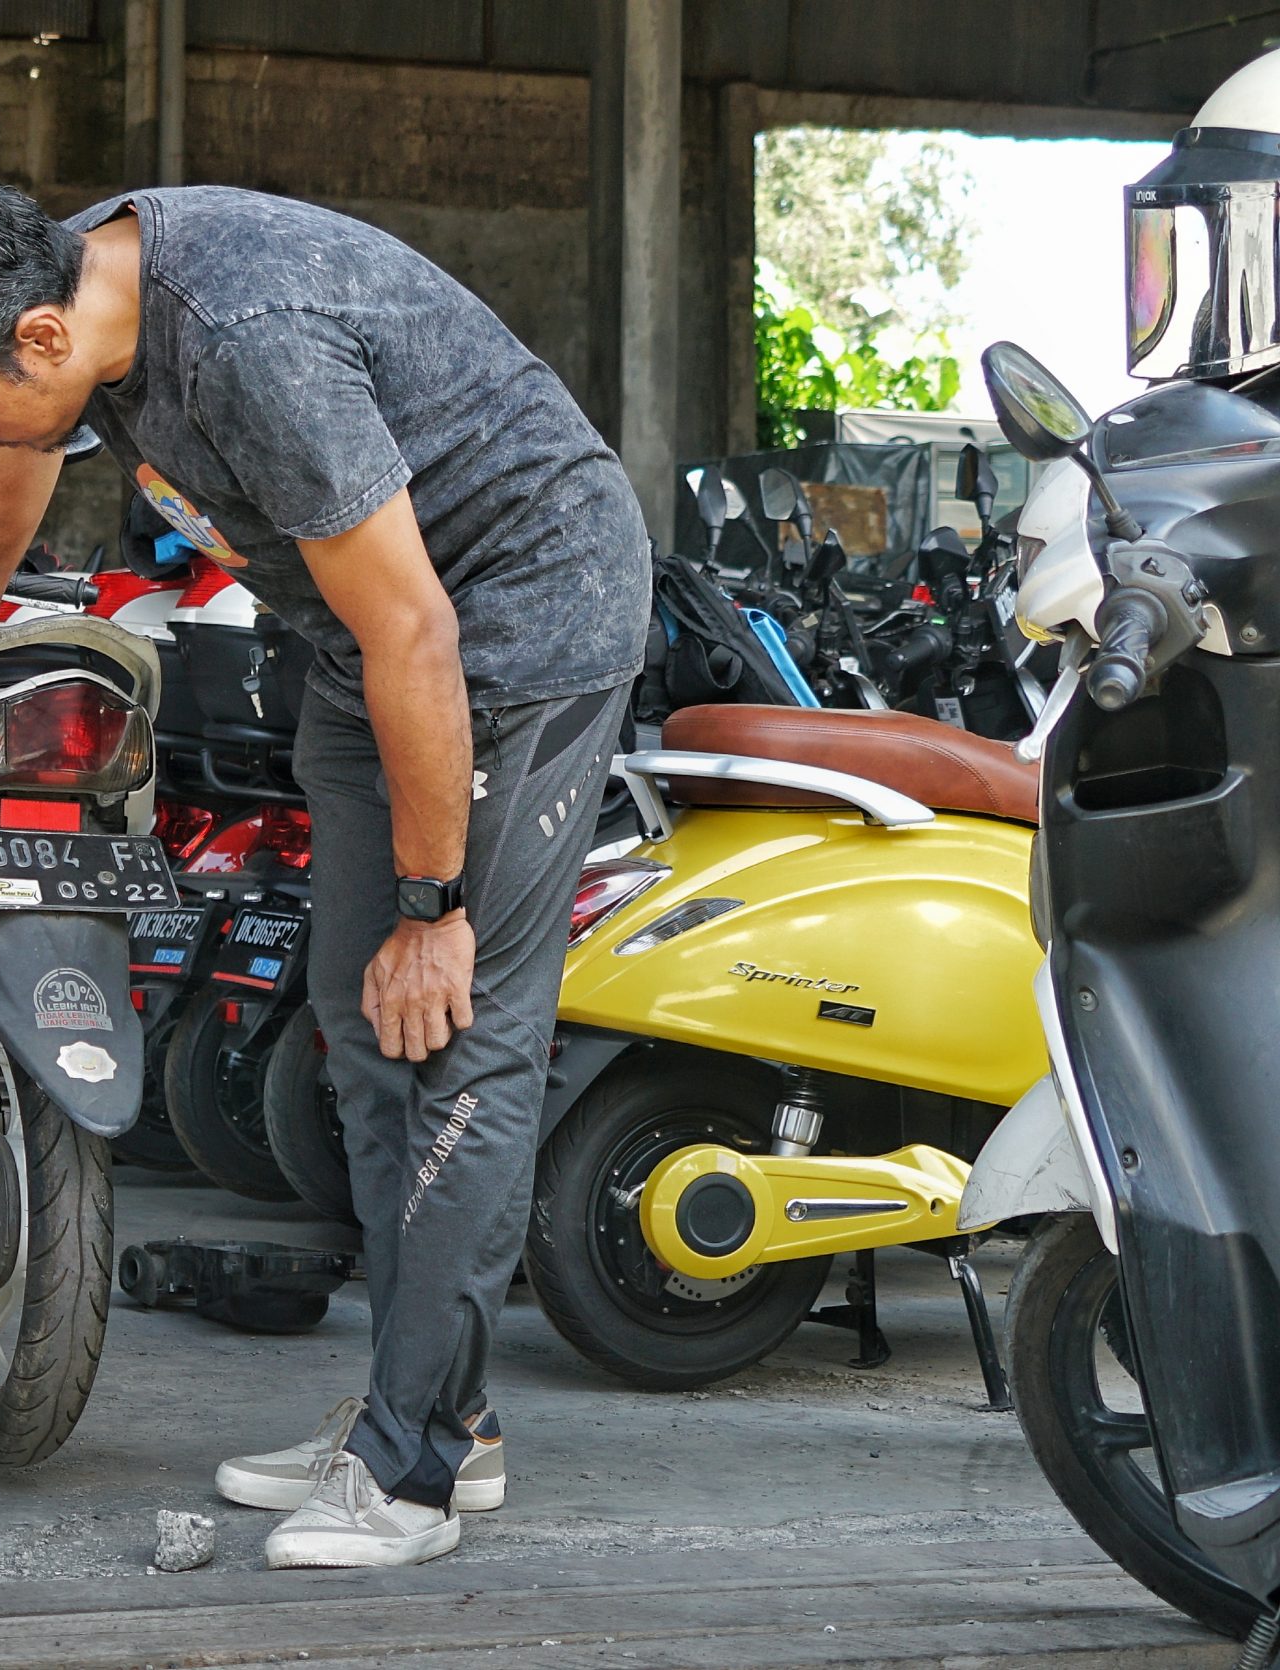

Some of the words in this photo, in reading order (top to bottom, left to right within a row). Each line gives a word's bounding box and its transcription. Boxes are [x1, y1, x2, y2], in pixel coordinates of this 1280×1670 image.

[57, 881, 98, 899] 06
[125, 883, 168, 901] 22
[728, 960, 861, 994] Sprinter
[47, 980, 96, 1002] 30%
[46, 1002, 78, 1012] LEBIH
[80, 1002, 100, 1013] IRIT
[408, 1158, 440, 1214] UNDER
[432, 1092, 479, 1163] ARMOUR
